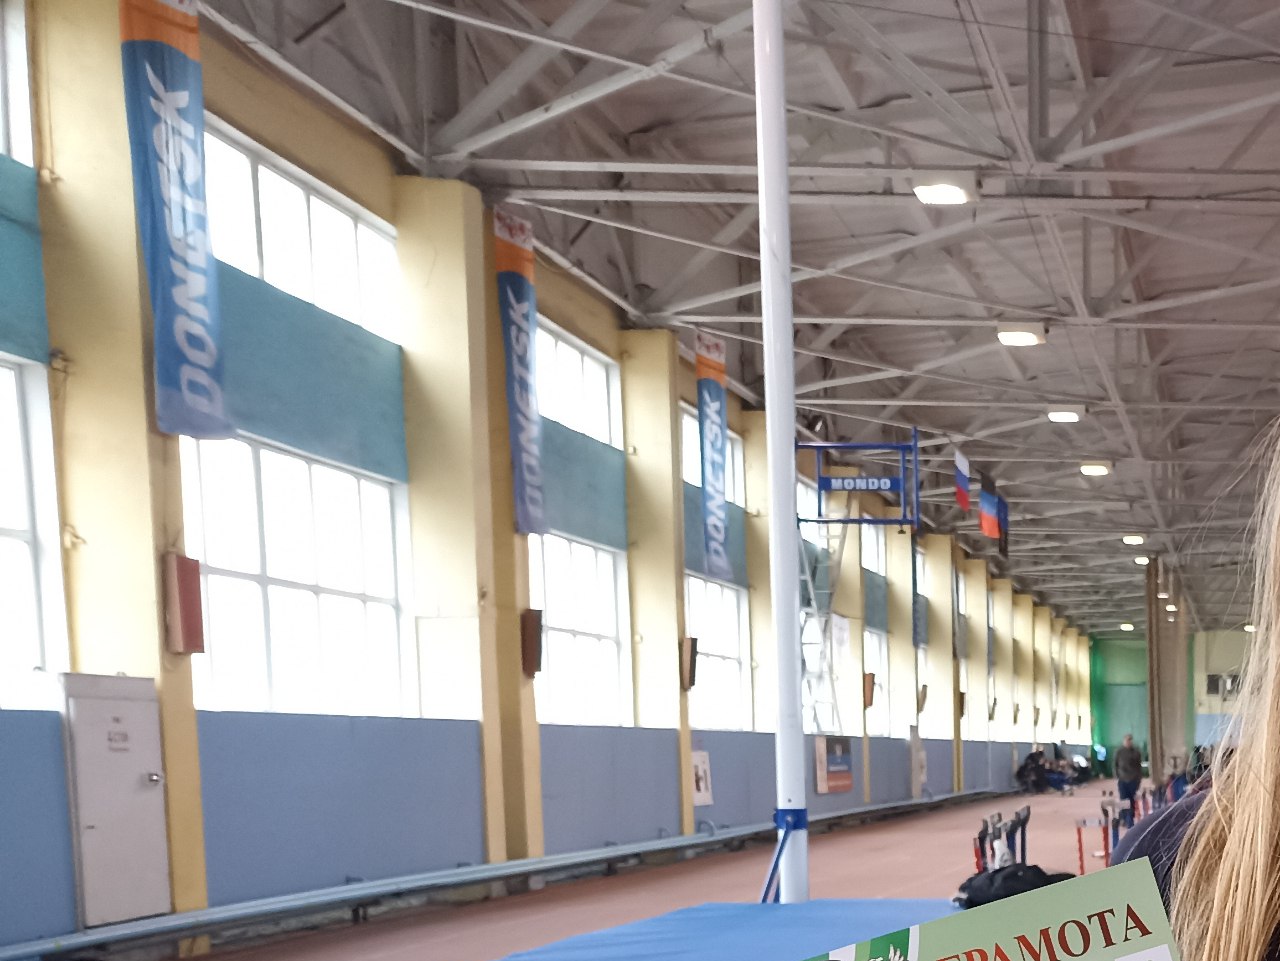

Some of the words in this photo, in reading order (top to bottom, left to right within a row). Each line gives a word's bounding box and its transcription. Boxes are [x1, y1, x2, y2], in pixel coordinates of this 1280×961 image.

[144, 60, 224, 418] DONETSK
[506, 285, 543, 518] DONETSK
[701, 389, 730, 570] DONETSK
[831, 478, 891, 490] MONDO
